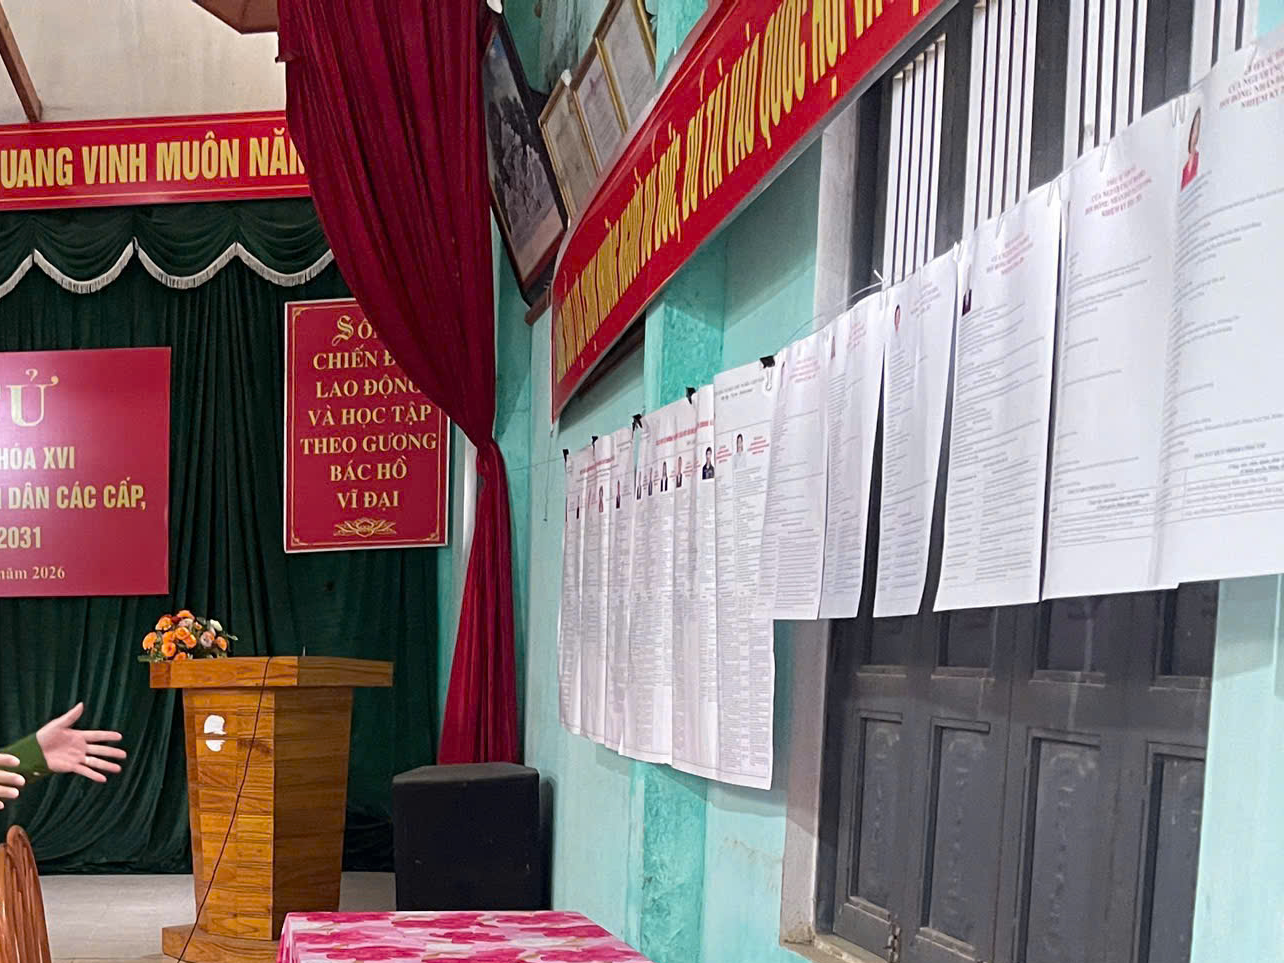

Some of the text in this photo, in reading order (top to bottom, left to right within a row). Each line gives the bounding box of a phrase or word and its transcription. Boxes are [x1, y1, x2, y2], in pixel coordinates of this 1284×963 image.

[702, 57, 729, 200] TÀI
[726, 22, 760, 175] VÀO
[82, 144, 146, 184] VINH
[156, 130, 239, 181] MUÔN
[313, 343, 378, 371] CHIẾN
[316, 380, 359, 399] LAO
[308, 402, 432, 429] VÀ HỌC TẬP
[43, 445, 75, 470] XVI
[300, 433, 437, 455] THEO GƯƠNG
[330, 455, 407, 482] BÁC HỒ
[9, 480, 49, 509] DÂN
[56, 481, 97, 510] CÁC
[103, 476, 146, 510] CẤP,
[337, 489, 399, 511] VĨ ĐẠI
[32, 566, 66, 580] 2026
